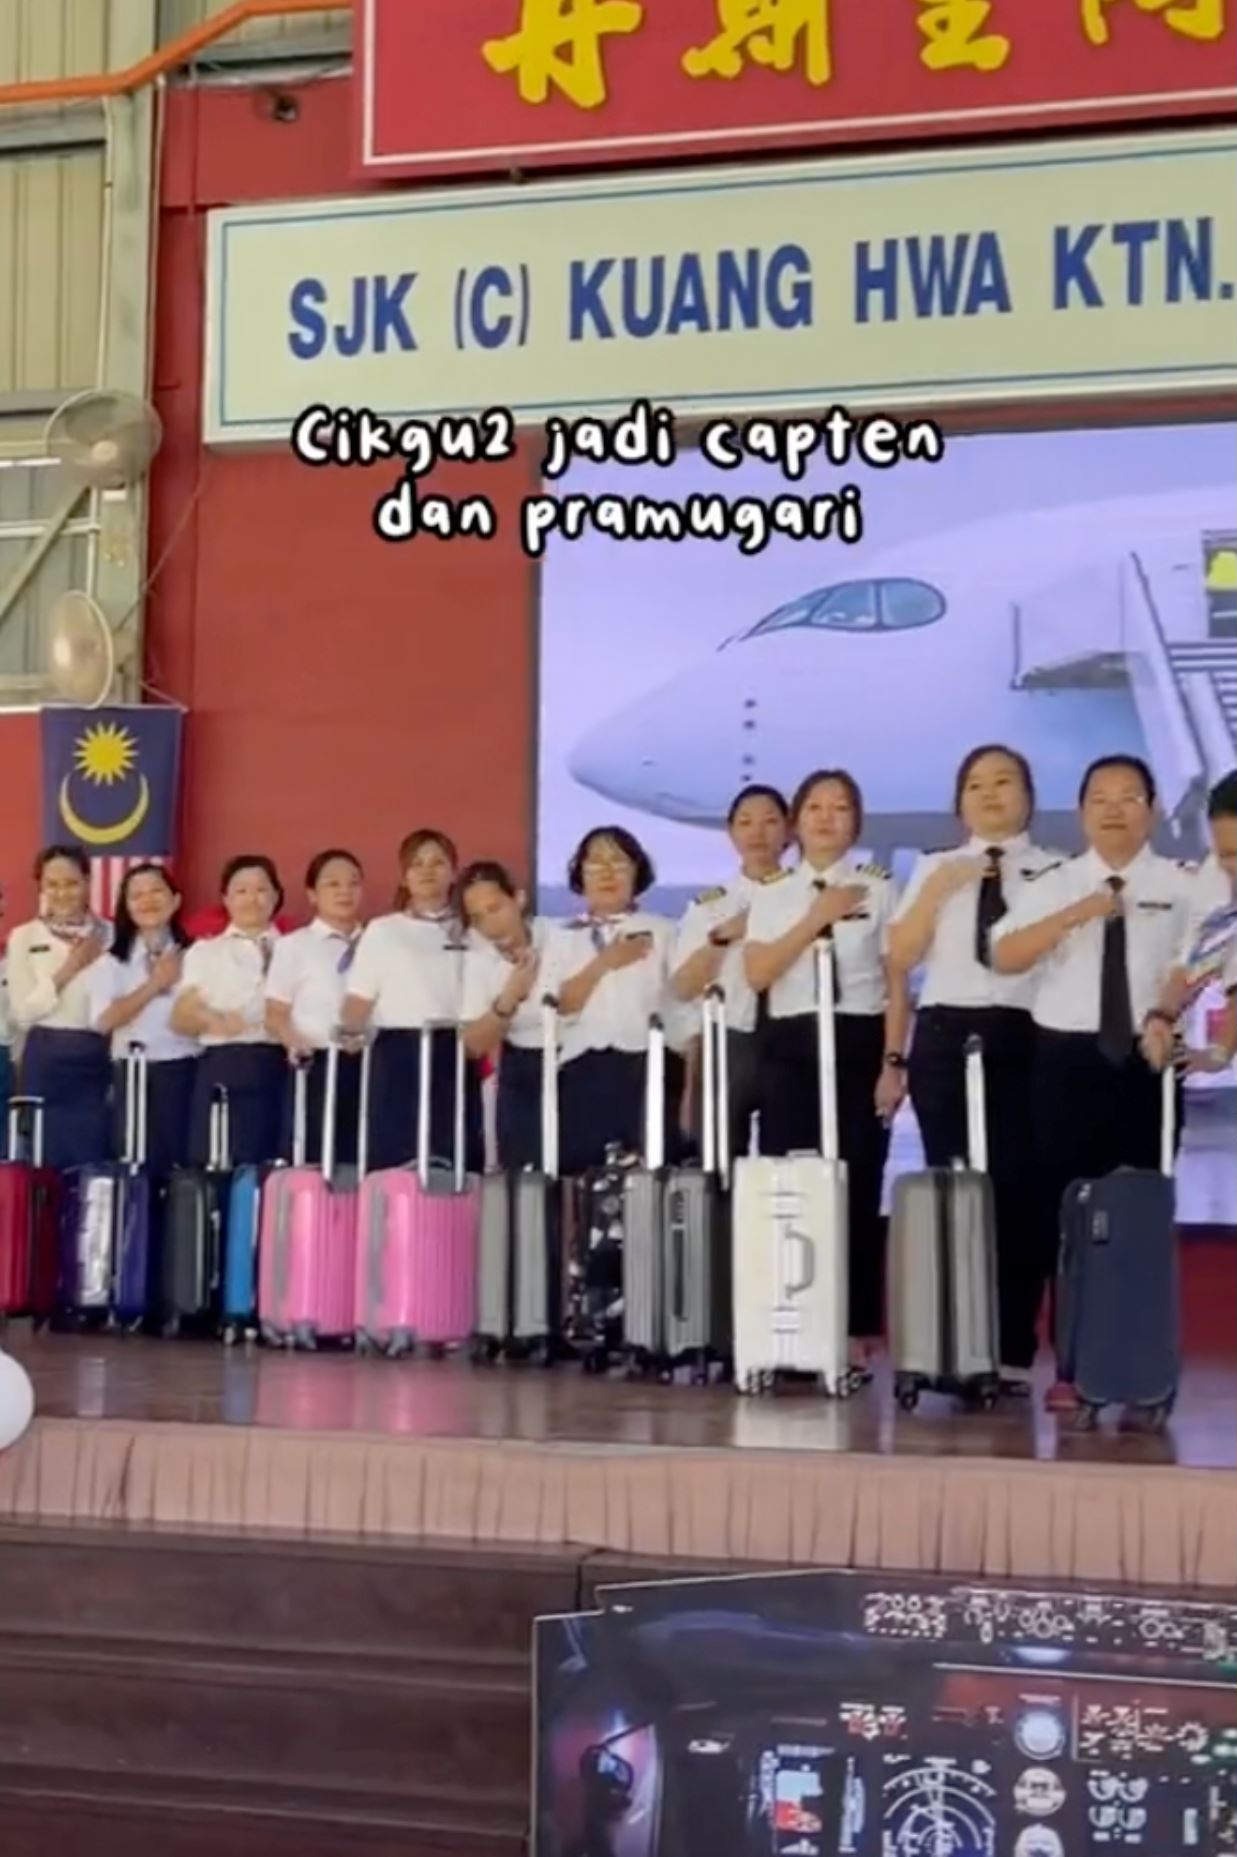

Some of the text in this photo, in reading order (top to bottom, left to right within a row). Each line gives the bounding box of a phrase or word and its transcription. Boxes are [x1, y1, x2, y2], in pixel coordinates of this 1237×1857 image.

[288, 216, 1234, 360] SJK (C) KUANG HWA KTN.
